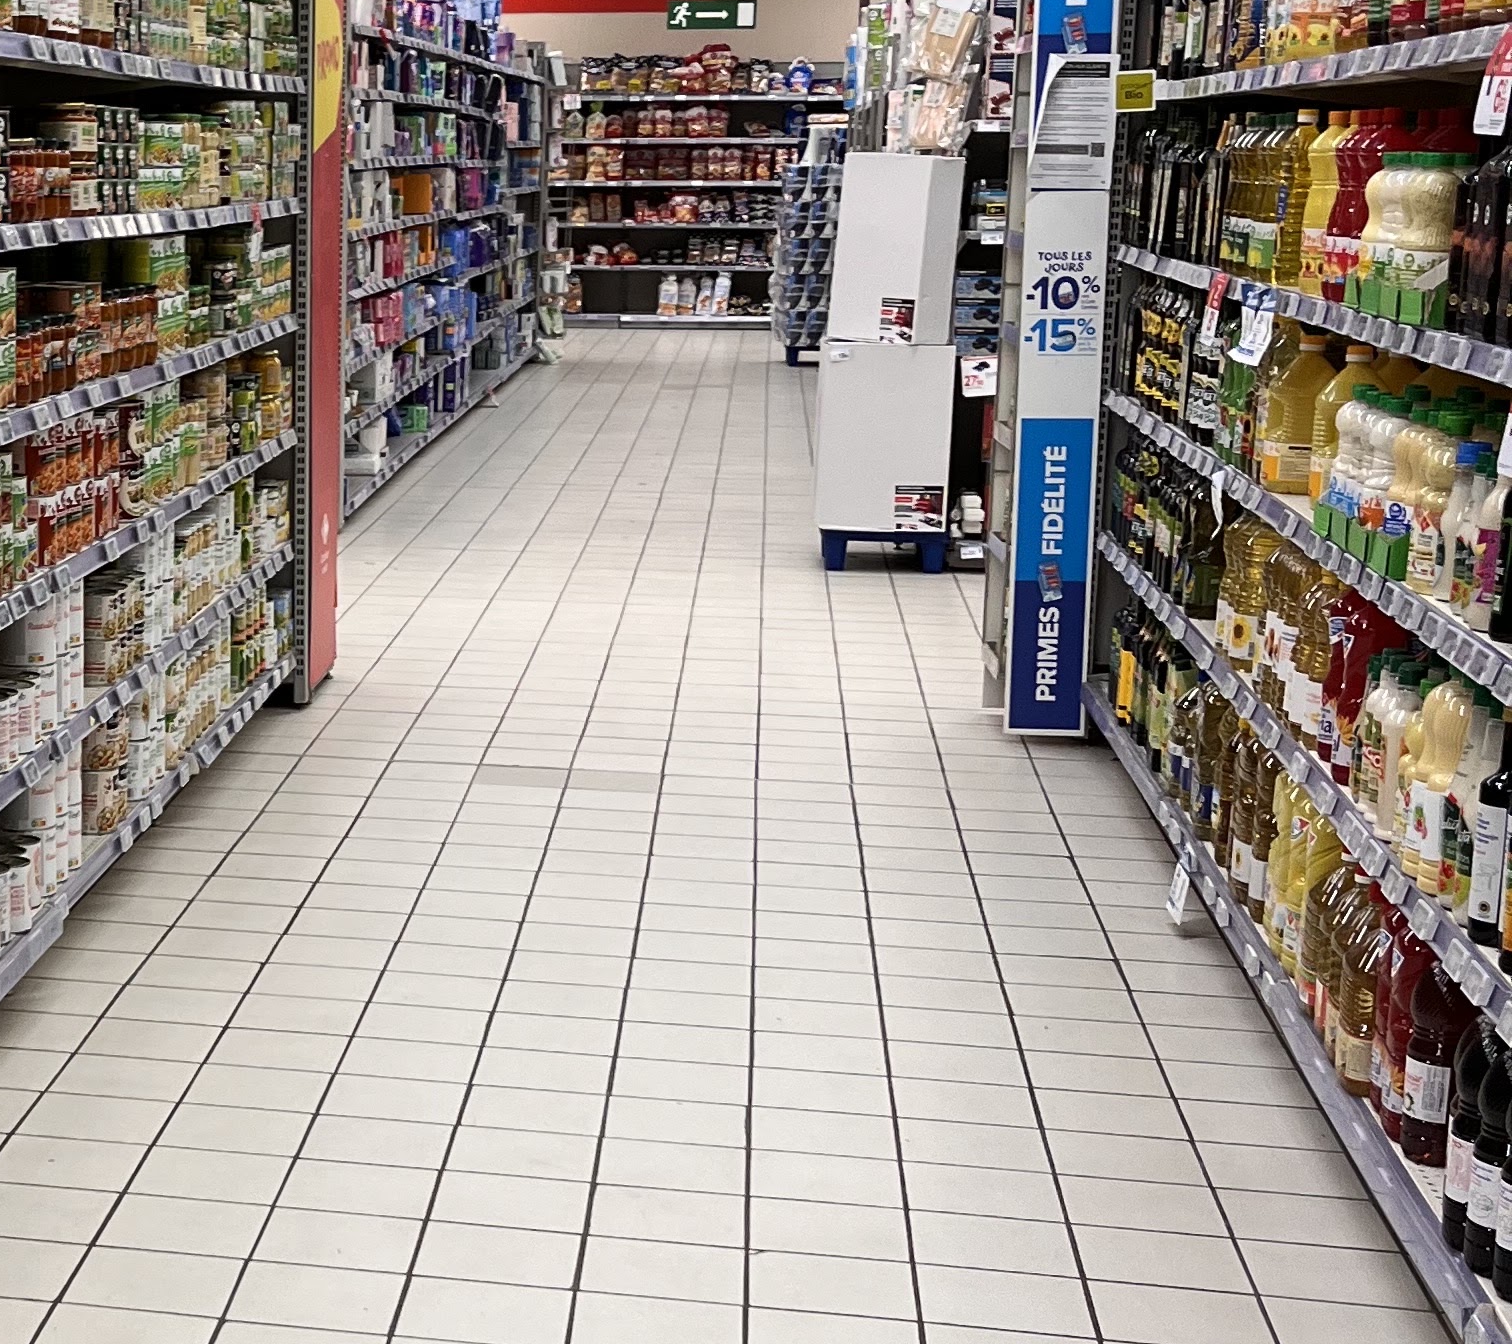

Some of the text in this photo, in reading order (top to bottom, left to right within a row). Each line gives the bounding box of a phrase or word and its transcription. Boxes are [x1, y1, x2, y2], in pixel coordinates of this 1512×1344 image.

[1038, 251, 1092, 261] TOUS LES
[1044, 262, 1084, 275] JOURS
[1026, 276, 1100, 310] -10%
[1024, 318, 1096, 351] -15%
[1041, 446, 1067, 555] FIDÉLITÉ
[1035, 606, 1060, 702] PRIMES
